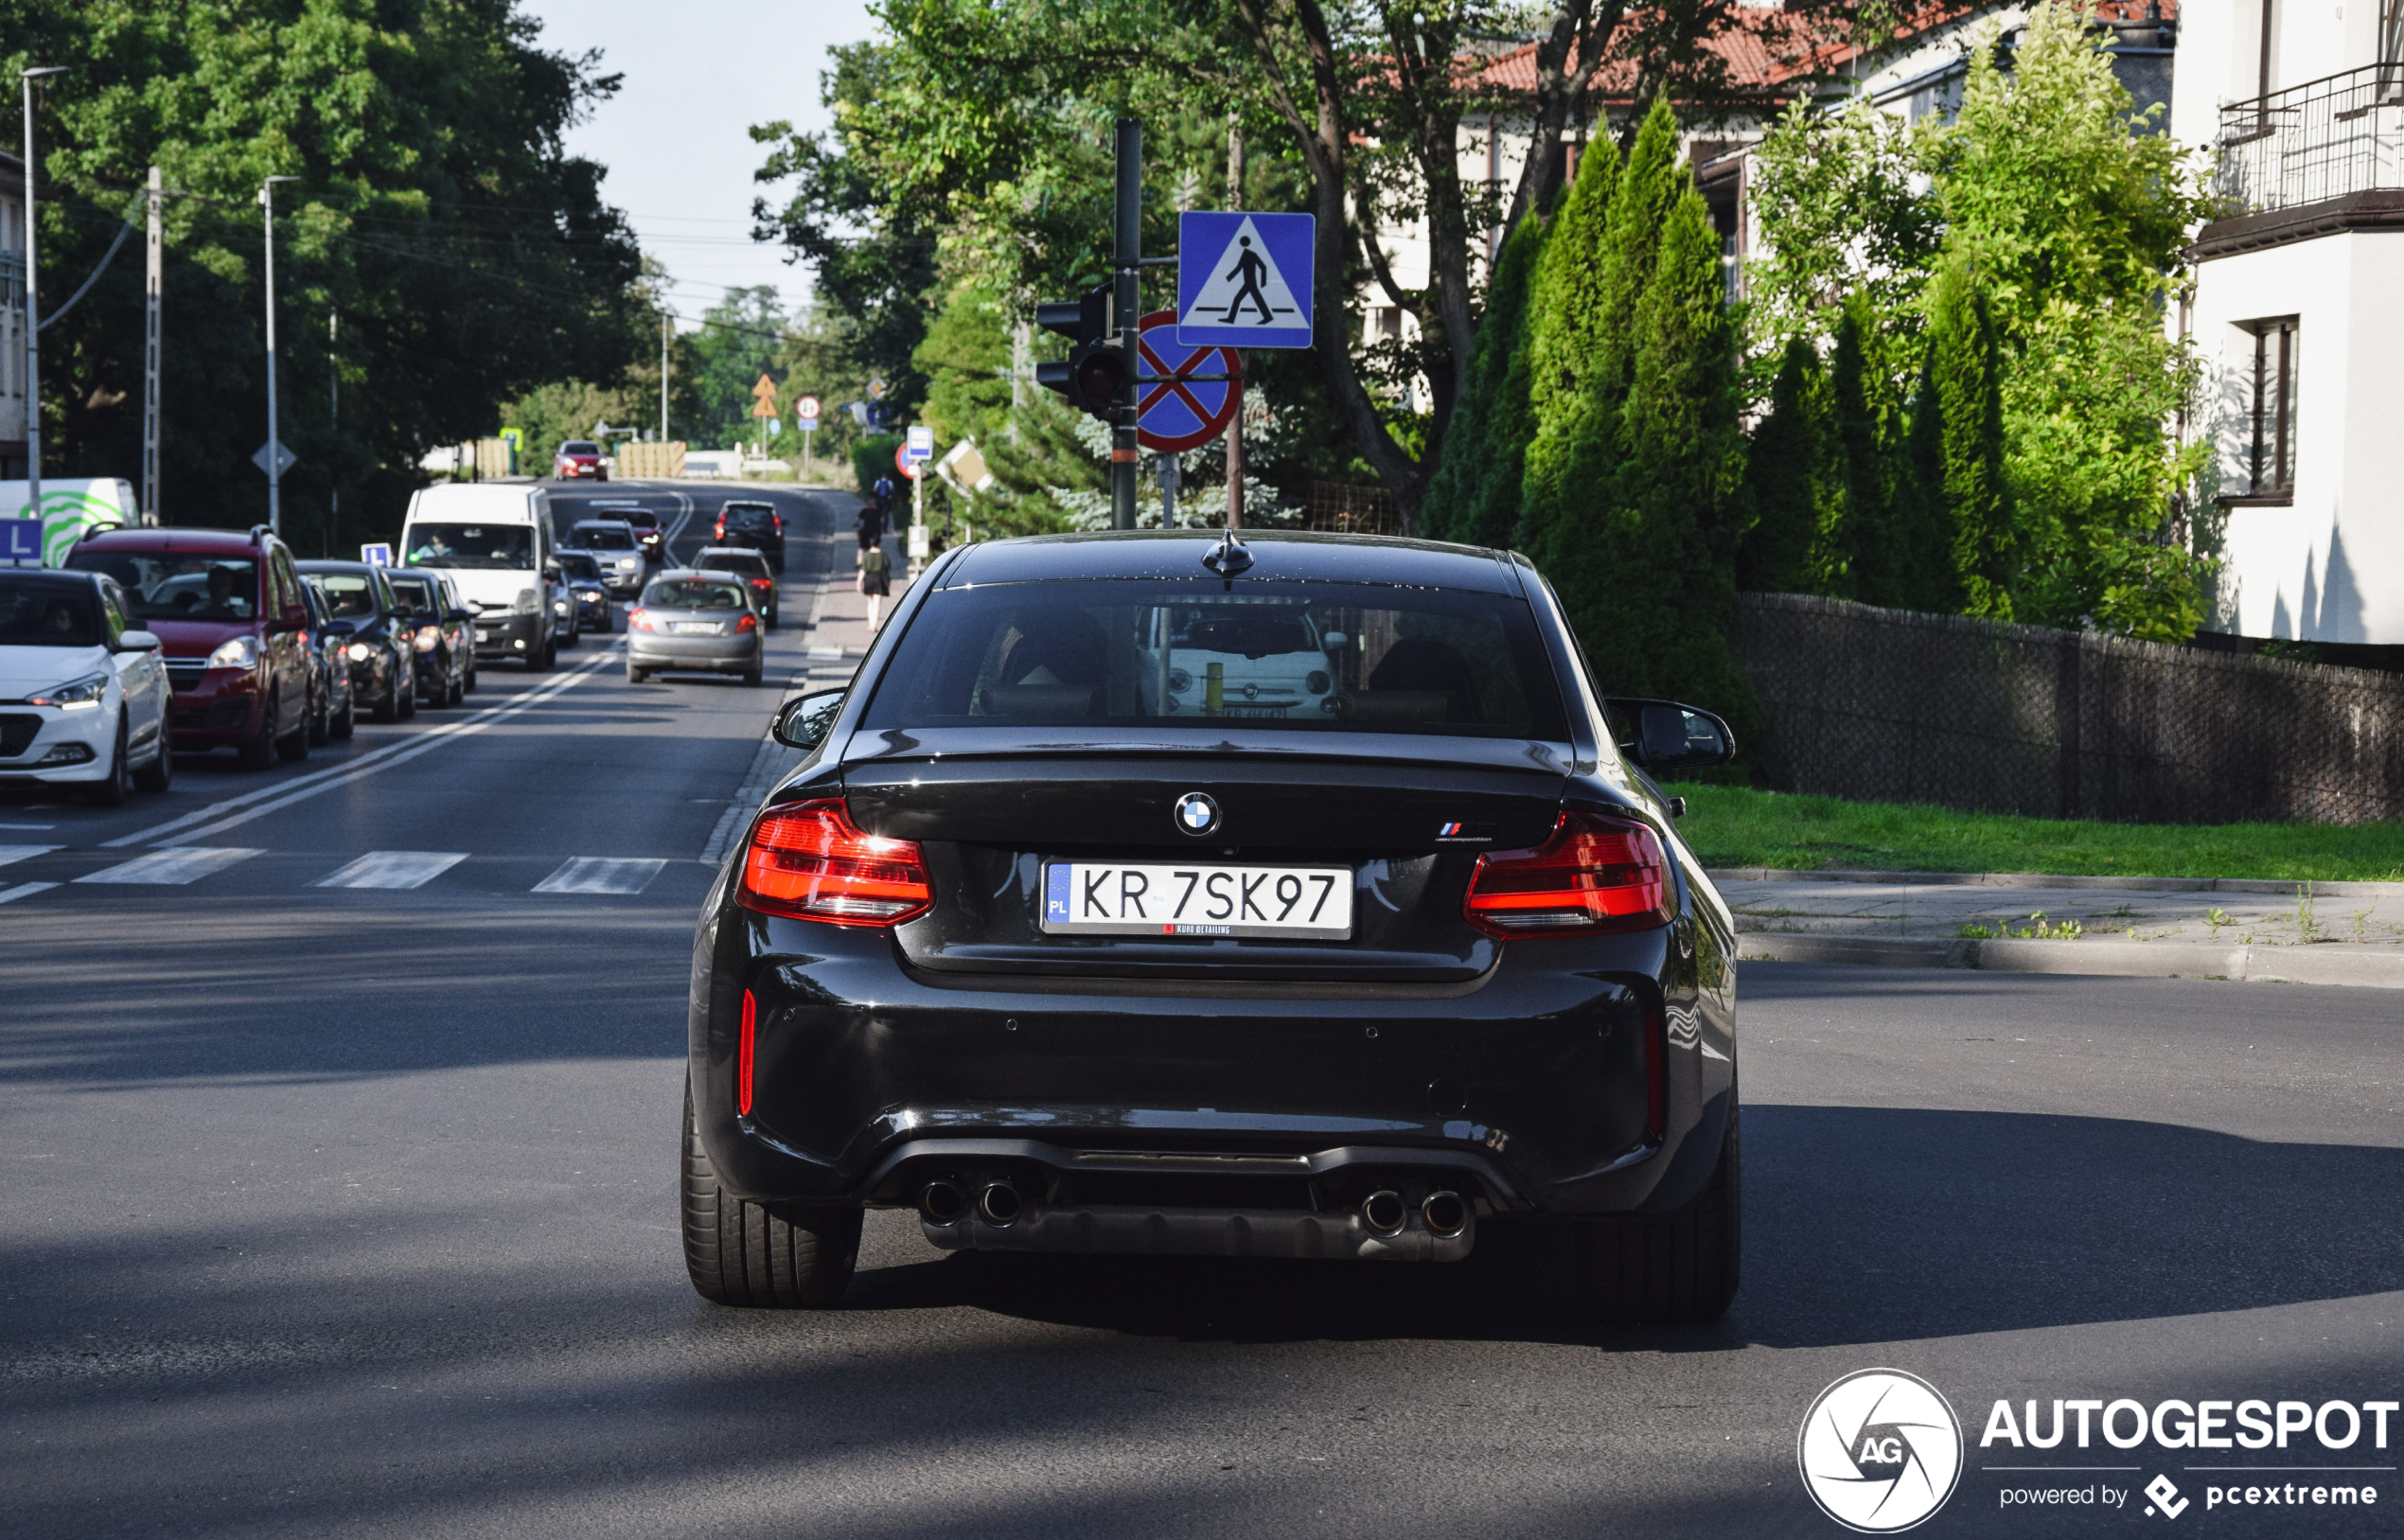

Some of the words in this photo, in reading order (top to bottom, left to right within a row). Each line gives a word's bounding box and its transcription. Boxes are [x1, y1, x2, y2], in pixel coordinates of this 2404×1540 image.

[11, 525, 31, 554] L
[370, 548, 384, 565] L
[1084, 870, 1149, 918] KR
[1173, 872, 1335, 922] 7SK97
[1050, 902, 1068, 914] PL
[1196, 925, 1230, 934] DETAILING
